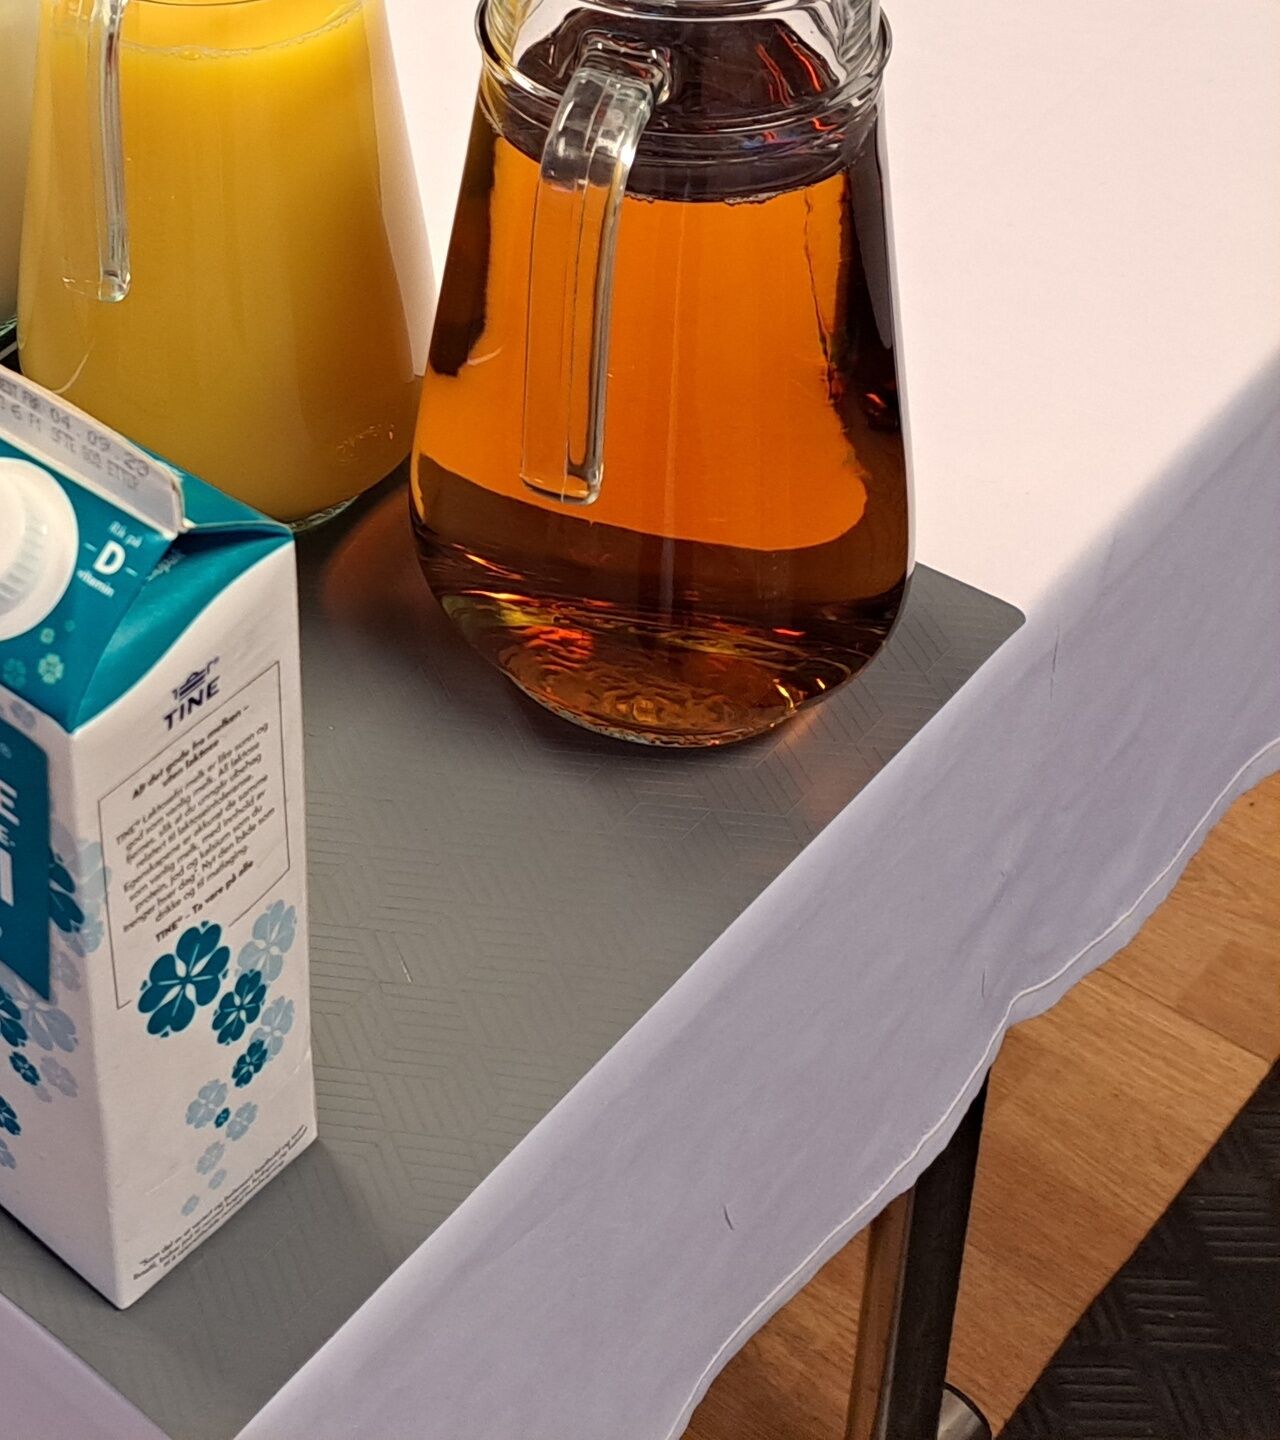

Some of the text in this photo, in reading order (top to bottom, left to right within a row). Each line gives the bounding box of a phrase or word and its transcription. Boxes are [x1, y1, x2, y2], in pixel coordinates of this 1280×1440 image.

[92, 539, 126, 576] D
[163, 676, 221, 731] TINE
[185, 739, 219, 768] laktose
[185, 769, 204, 789] melk
[256, 722, 268, 734] og
[145, 816, 163, 833] som
[230, 742, 259, 766] laktose
[184, 805, 195, 816] du
[229, 753, 261, 780] ubehag
[129, 884, 147, 901] som
[149, 862, 175, 883] vanlig
[201, 822, 221, 843] med
[186, 857, 198, 869] og
[232, 816, 249, 832] som
[251, 805, 262, 817] du
[217, 842, 234, 858] den
[257, 807, 274, 824] som
[183, 887, 195, 899] og
